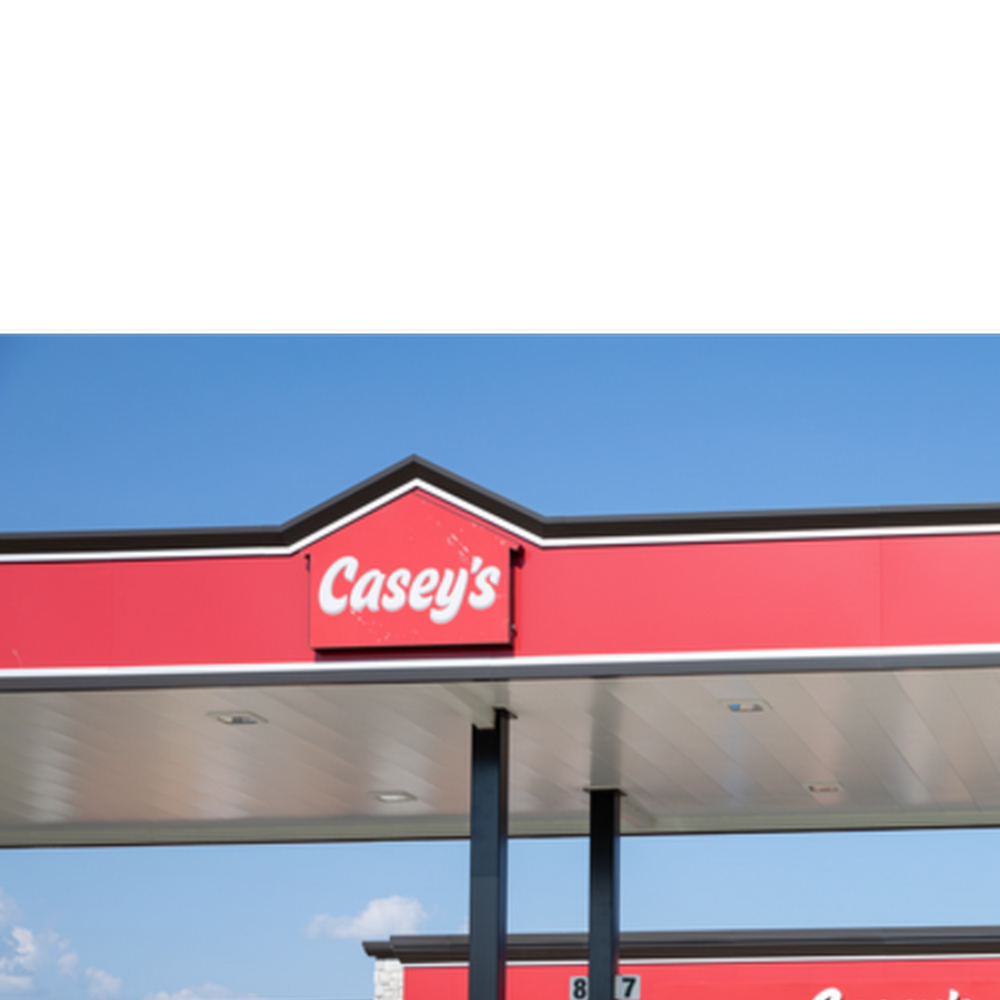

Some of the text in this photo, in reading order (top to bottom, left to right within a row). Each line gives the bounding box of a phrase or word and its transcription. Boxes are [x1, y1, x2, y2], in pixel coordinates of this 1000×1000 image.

[318, 555, 501, 625] Casey's
[573, 977, 587, 999] 8
[621, 977, 636, 997] 7
